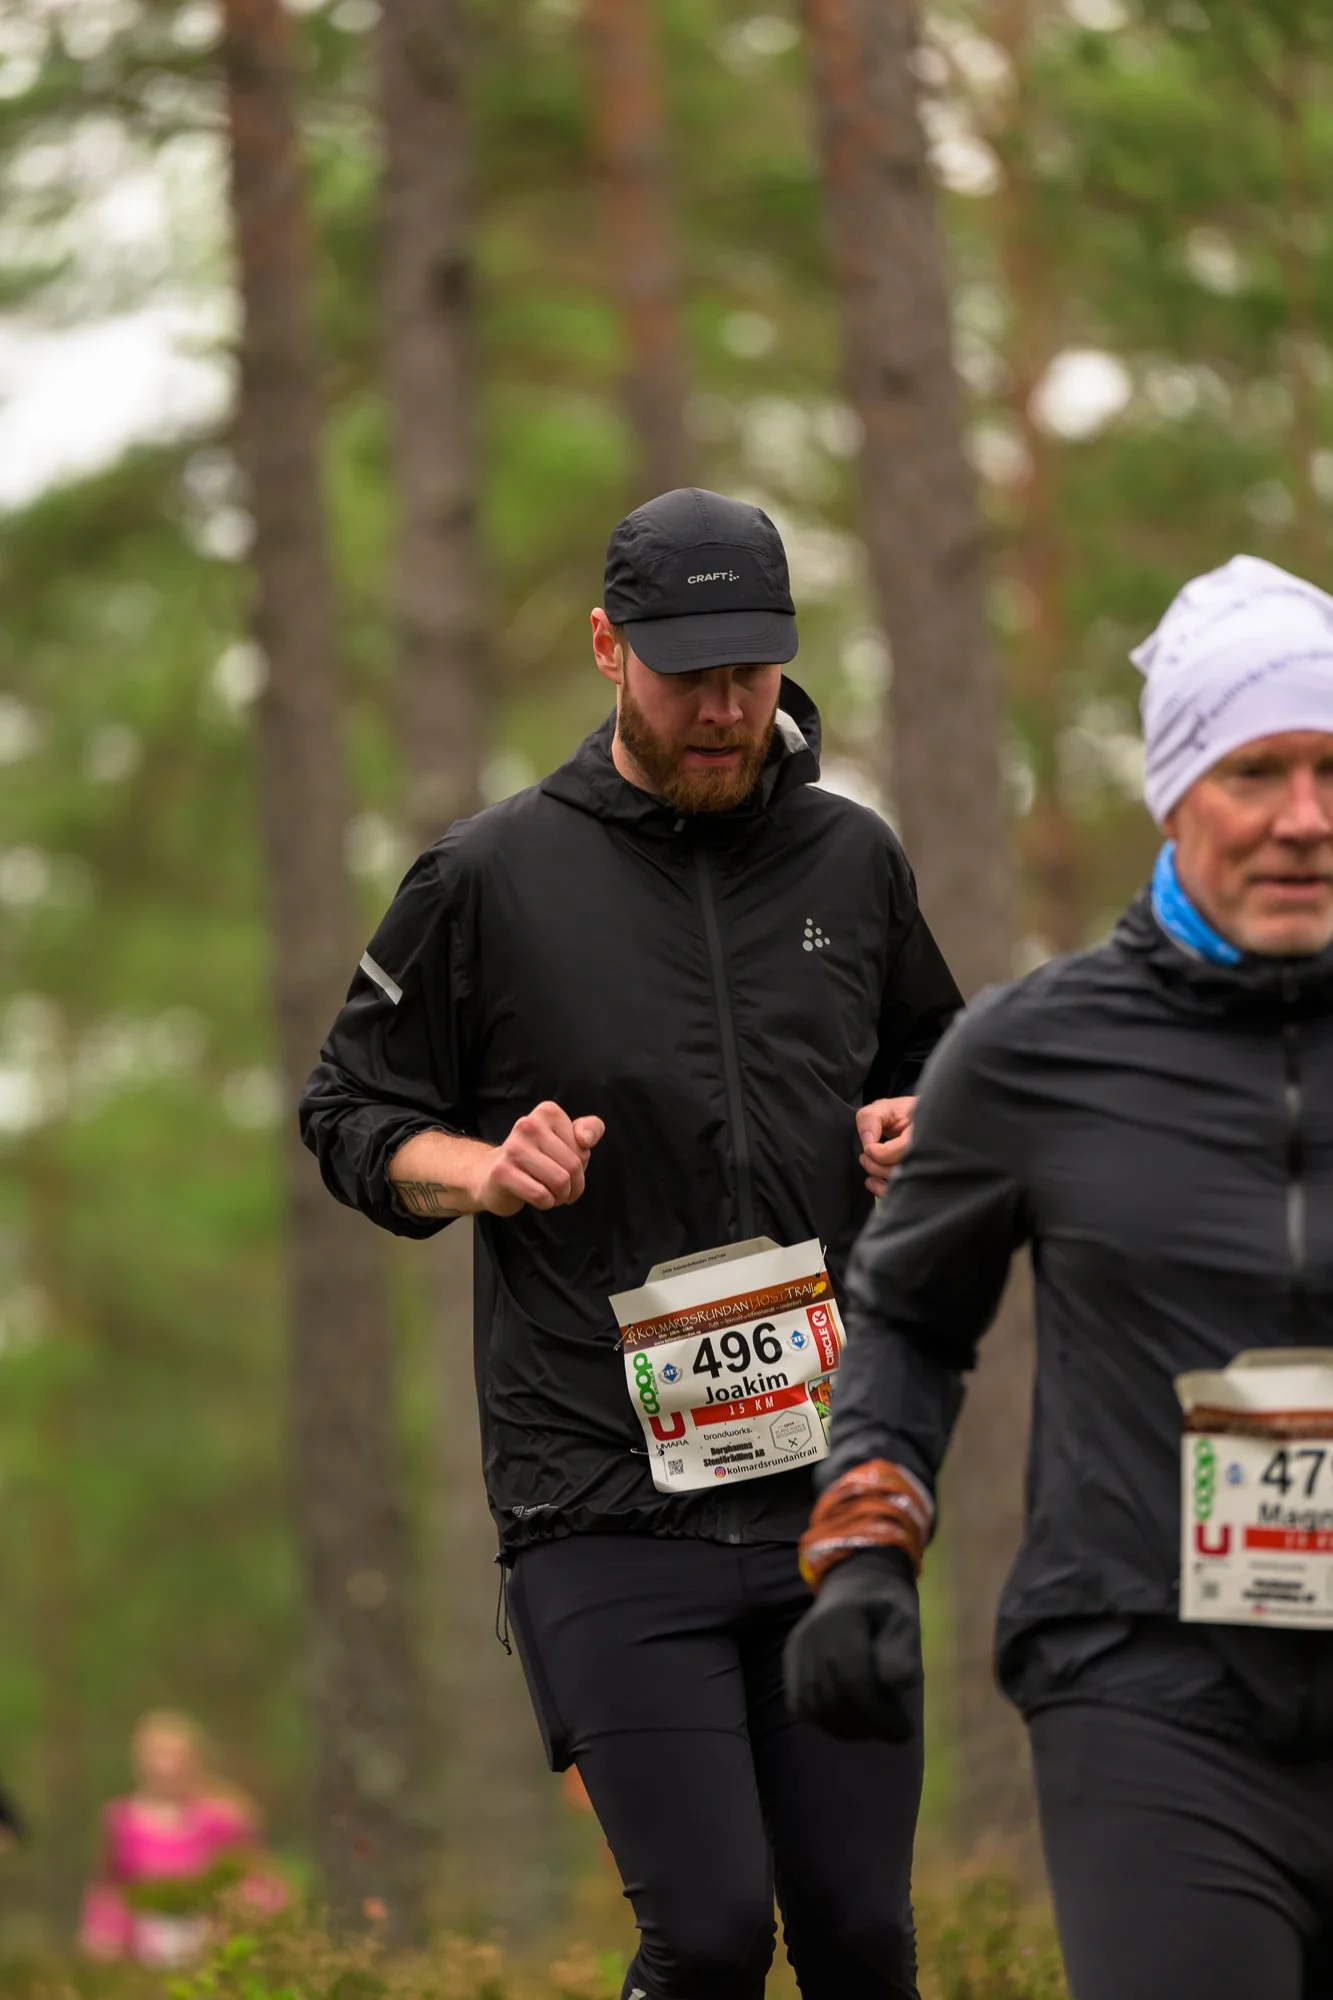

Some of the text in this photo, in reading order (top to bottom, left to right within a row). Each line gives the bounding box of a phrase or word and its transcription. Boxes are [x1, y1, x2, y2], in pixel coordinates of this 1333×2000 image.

[687, 572, 728, 584] CRAFT
[692, 1322, 783, 1379] 496
[818, 1327, 834, 1366] CIRCLE
[633, 1352, 660, 1415] coop
[705, 1372, 789, 1405] Joakim
[729, 1395, 774, 1416] 15 KM
[710, 1442, 753, 1456] Borghamns
[755, 1448, 766, 1458] AB
[1261, 1448, 1333, 1497] 47
